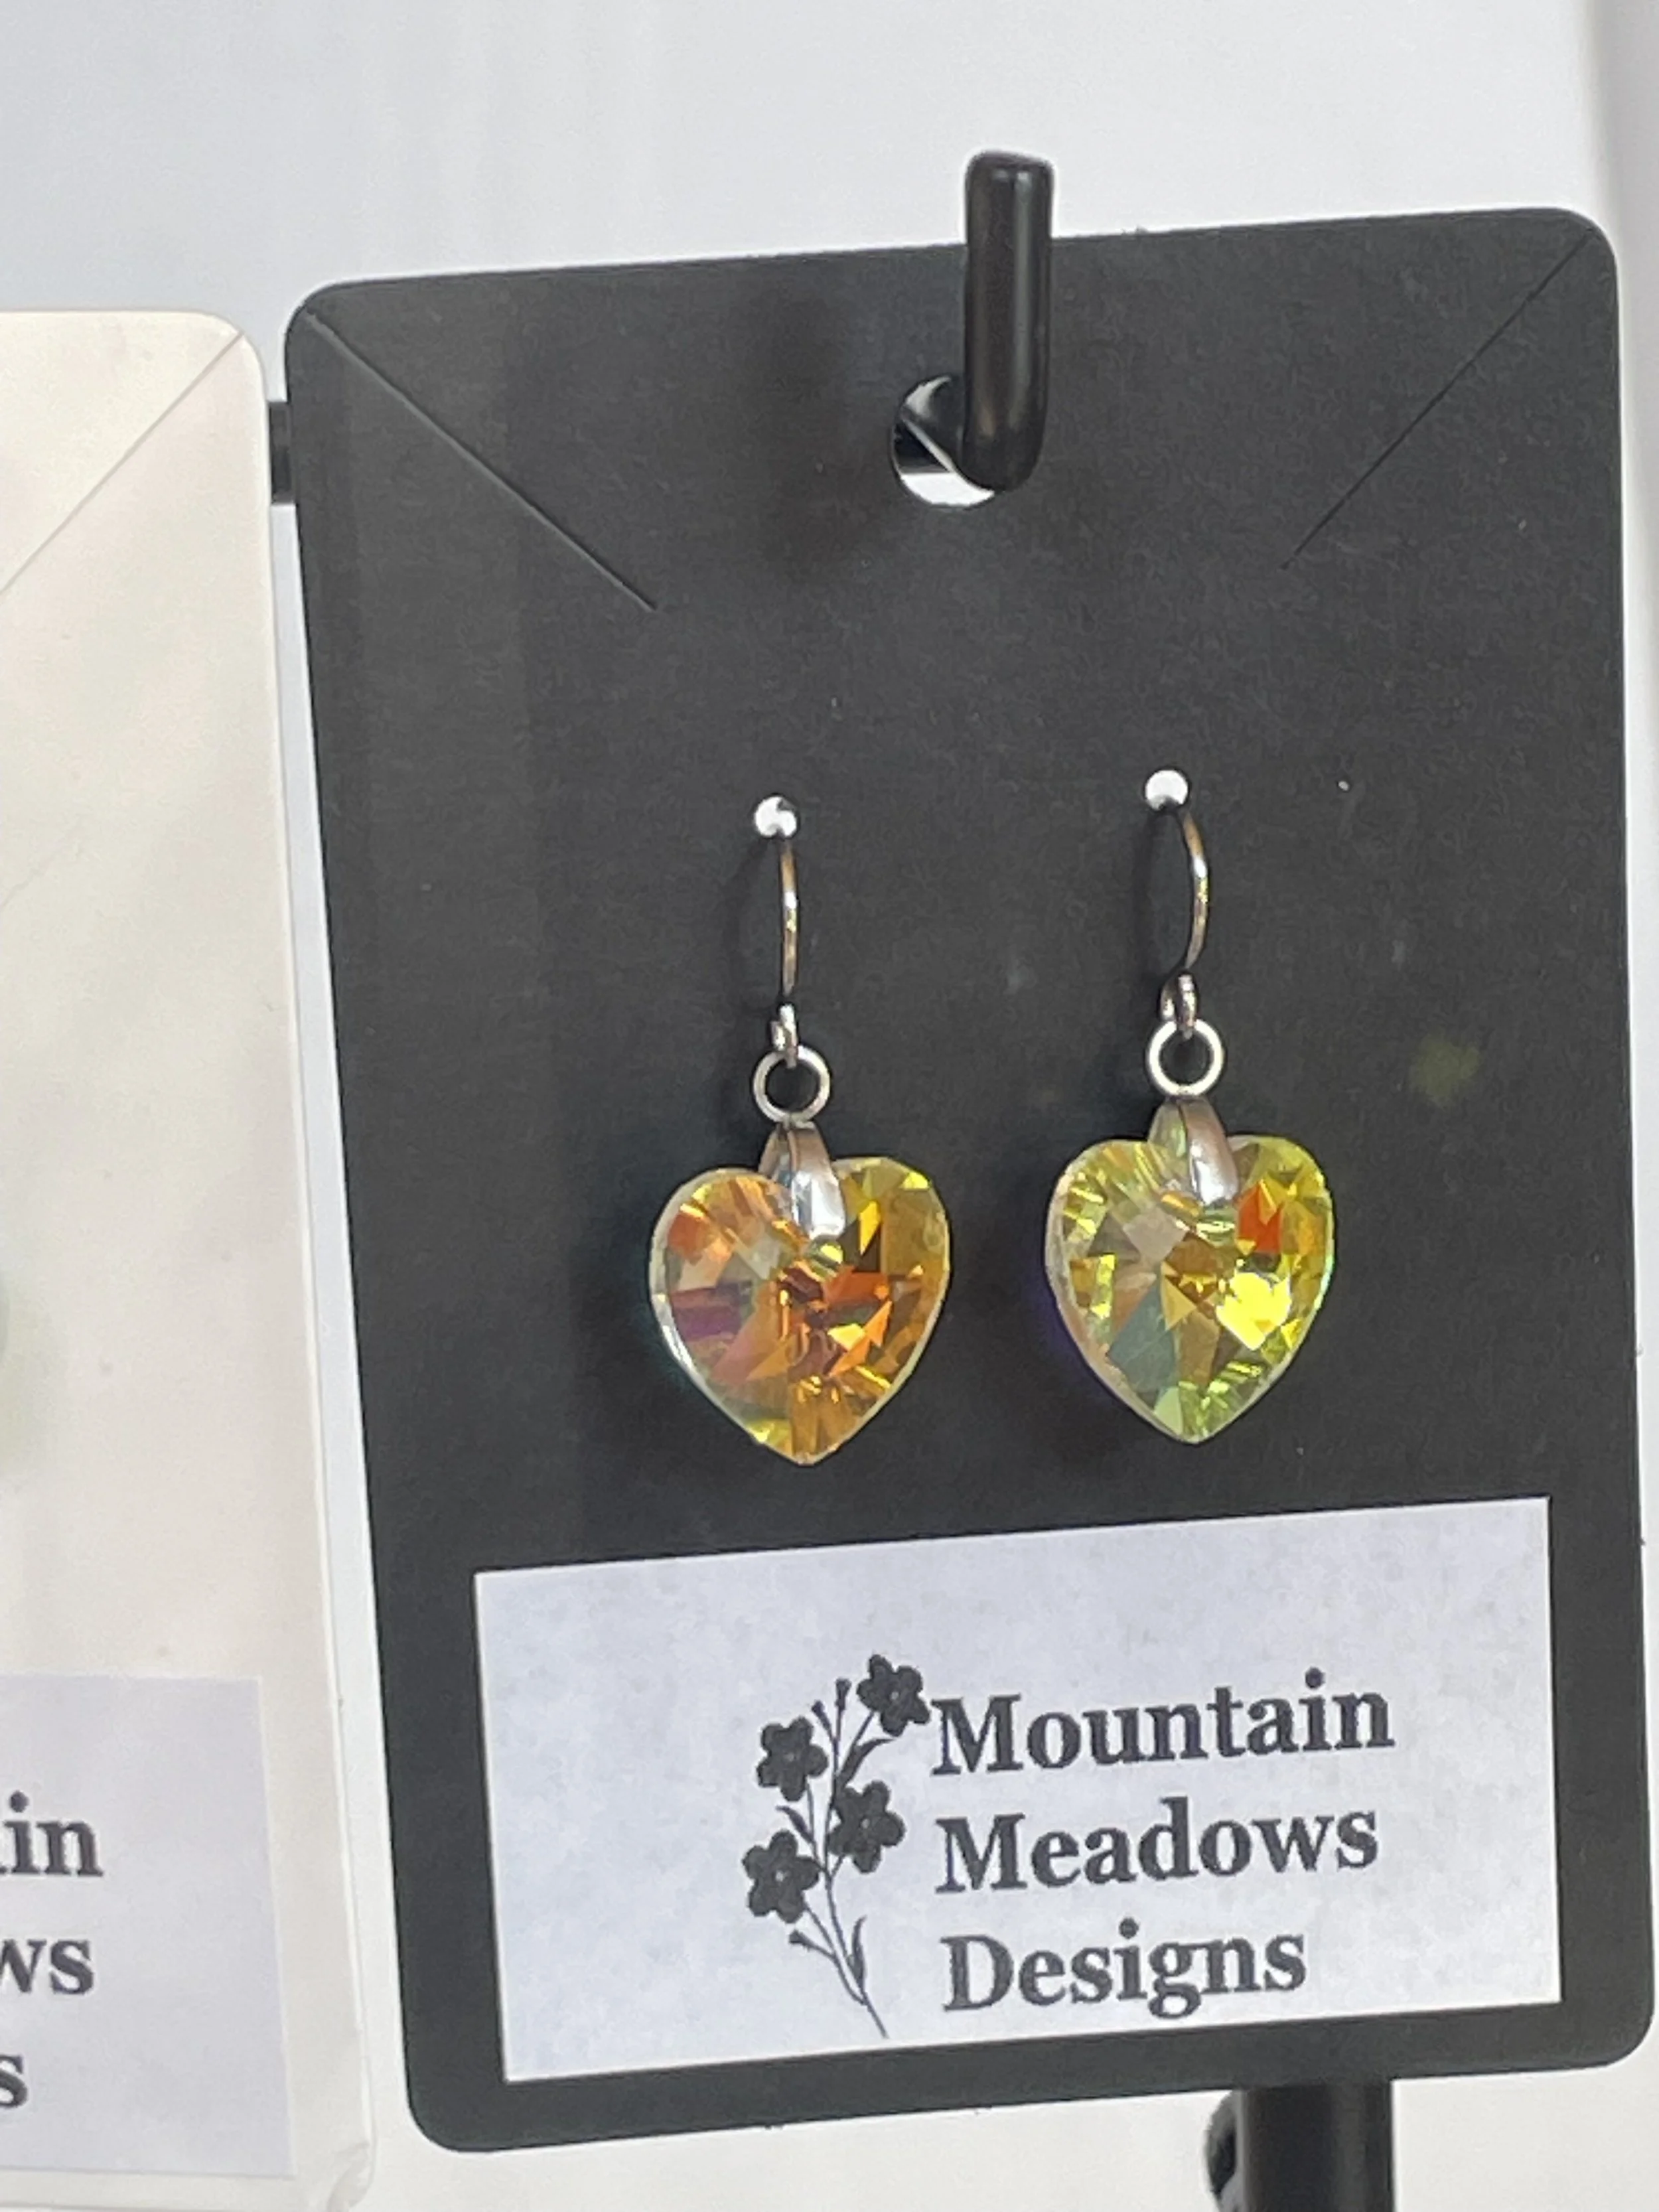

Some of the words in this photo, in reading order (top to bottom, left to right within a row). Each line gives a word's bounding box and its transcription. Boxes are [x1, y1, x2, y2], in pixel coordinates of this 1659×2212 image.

[930, 1667, 1395, 1776] Mountain
[0, 1791, 103, 1878] in
[936, 1796, 1378, 1893] Meadows
[940, 1918, 1306, 2019] Designs
